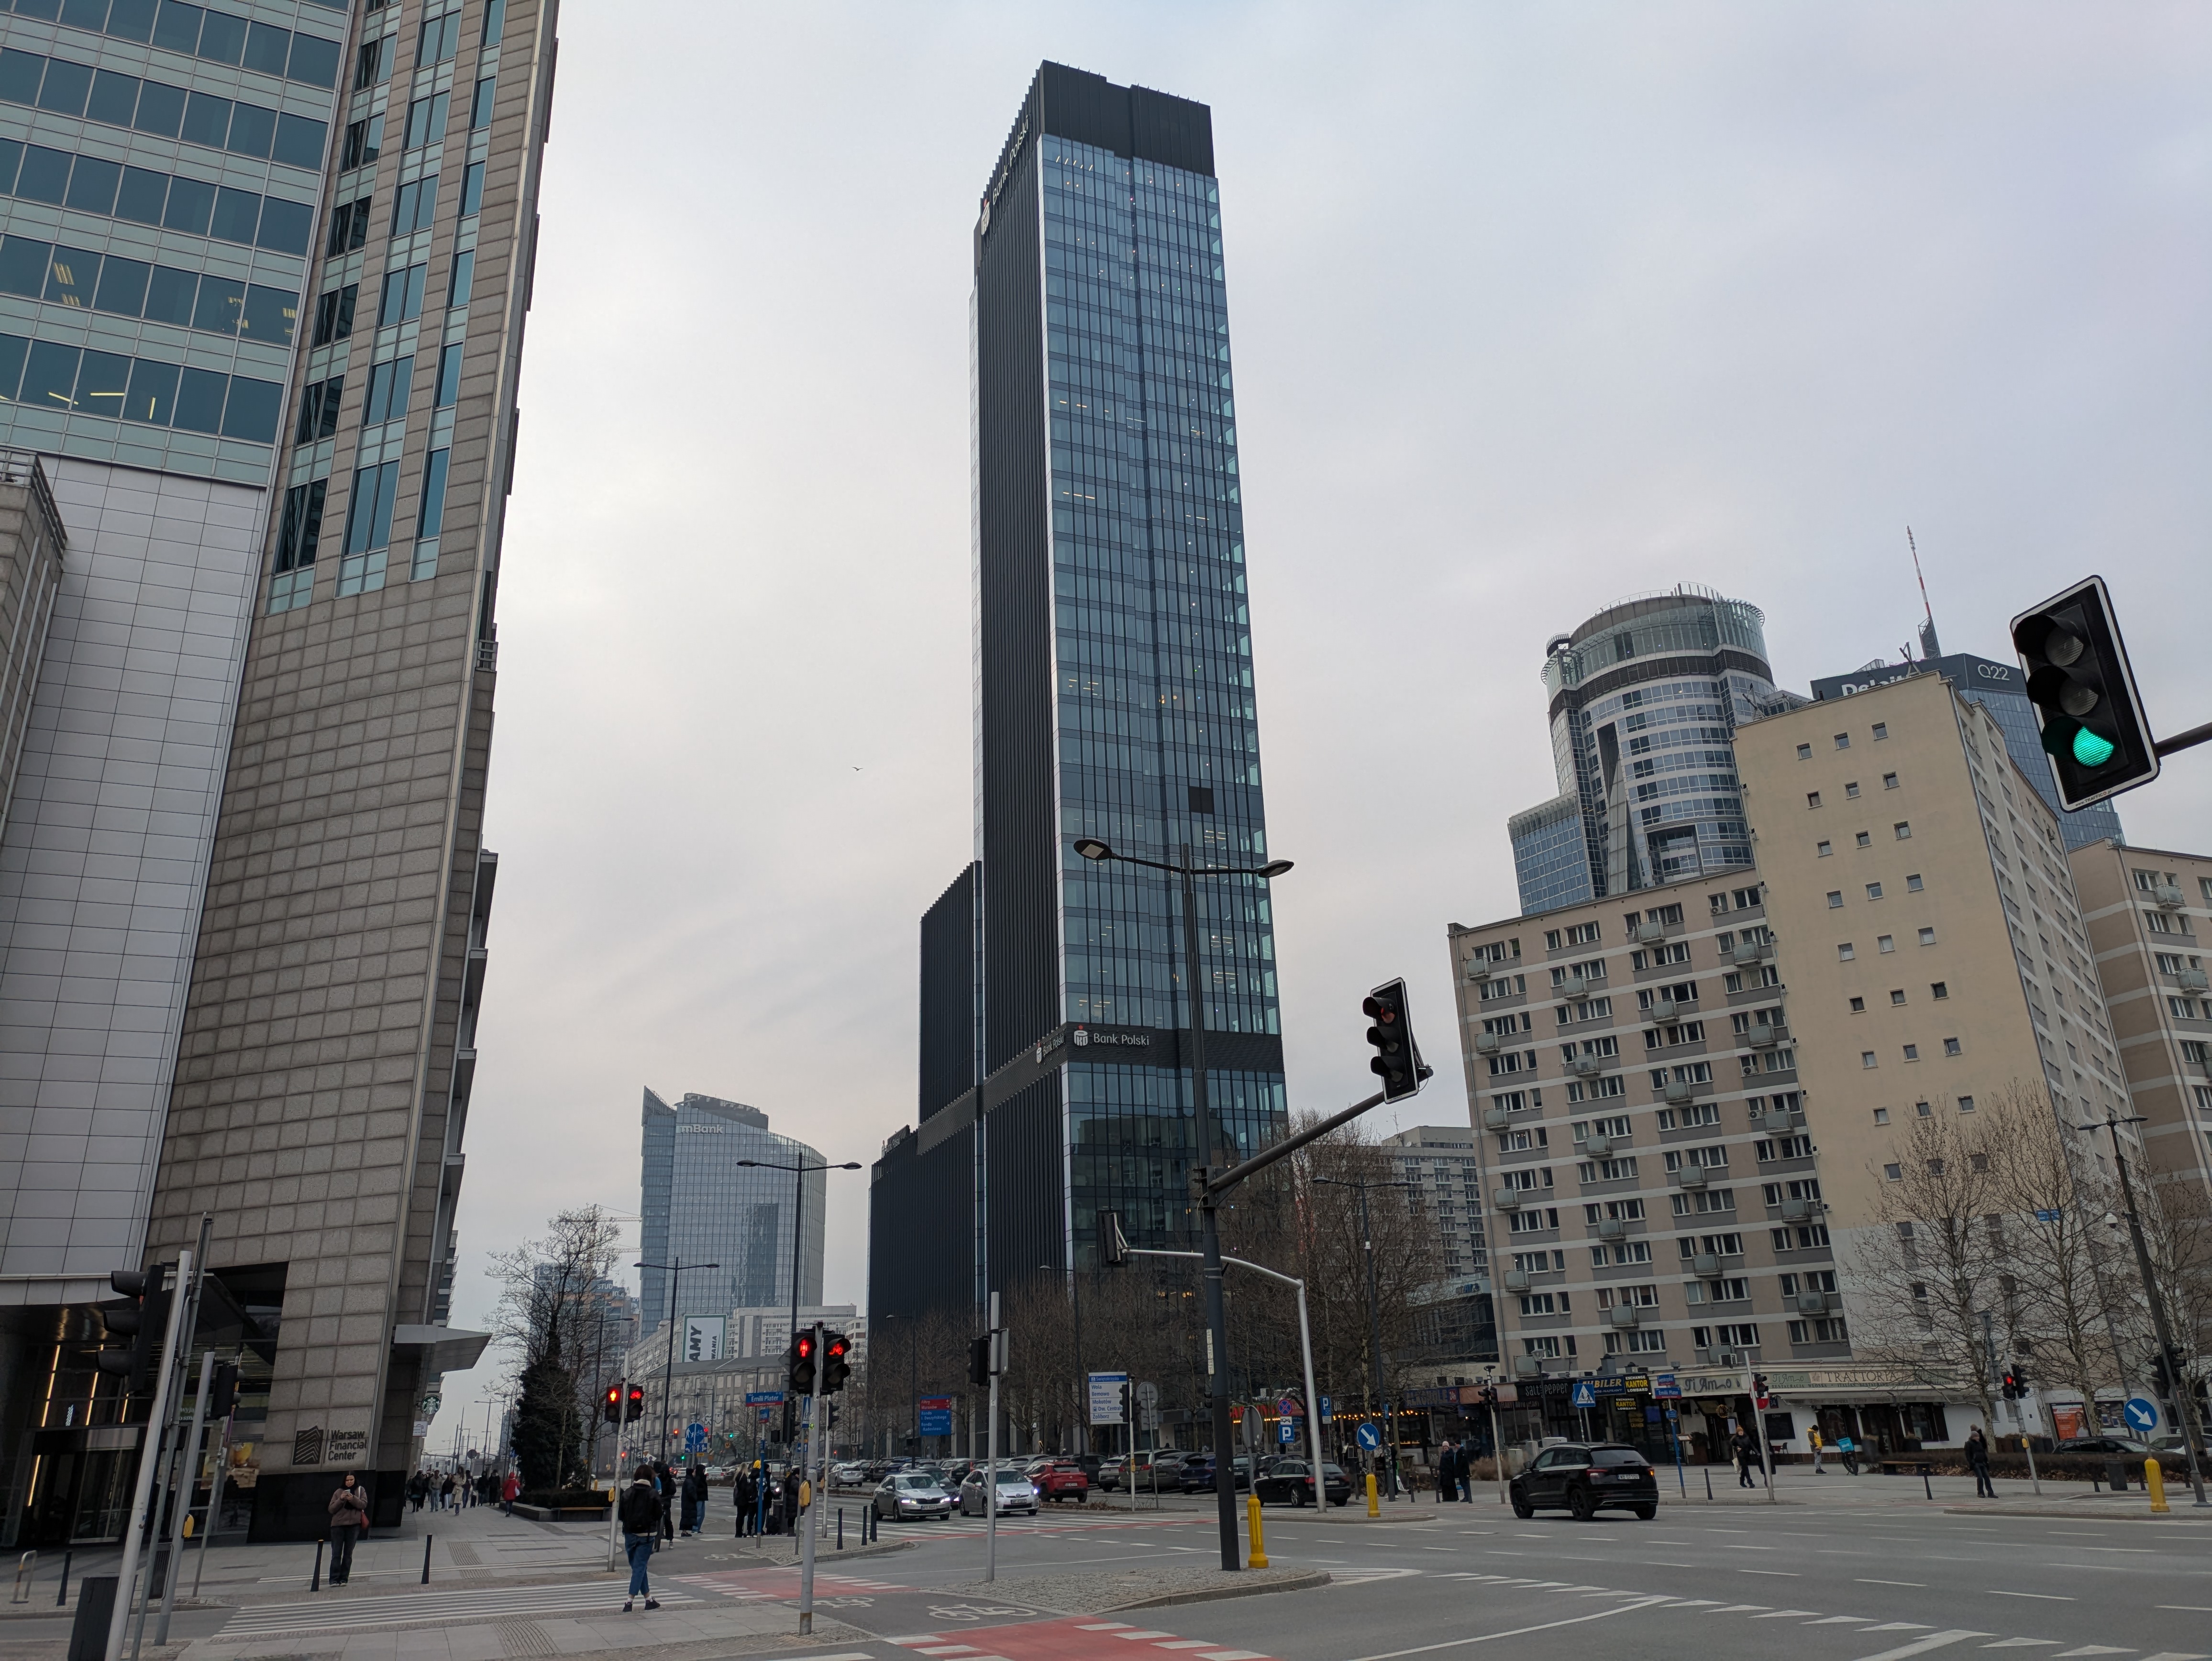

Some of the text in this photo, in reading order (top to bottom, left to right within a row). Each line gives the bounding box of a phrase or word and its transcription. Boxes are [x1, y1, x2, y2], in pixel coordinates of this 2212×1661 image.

[993, 164, 1008, 206] Bank
[1010, 115, 1029, 167] Polski
[1978, 664, 2010, 680] Q22
[1043, 1043, 1053, 1055] Bank
[1053, 1033, 1064, 1048] Polski
[1094, 1033, 1117, 1044] Bank
[1121, 1034, 1149, 1046] Polski
[680, 1124, 723, 1133] mBank
[1772, 1373, 1804, 1384] Ti Amo
[1825, 1371, 1896, 1382] TRATTORIA
[1625, 1379, 1648, 1388] KANTOR
[1684, 1378, 1695, 1391] Ti
[1695, 1378, 1732, 1393] Amo
[1525, 1385, 1541, 1396] salt
[1544, 1383, 1568, 1395] pepper
[331, 1429, 365, 1440] Warsaw
[329, 1439, 367, 1450] Financial
[328, 1451, 357, 1461] Center
